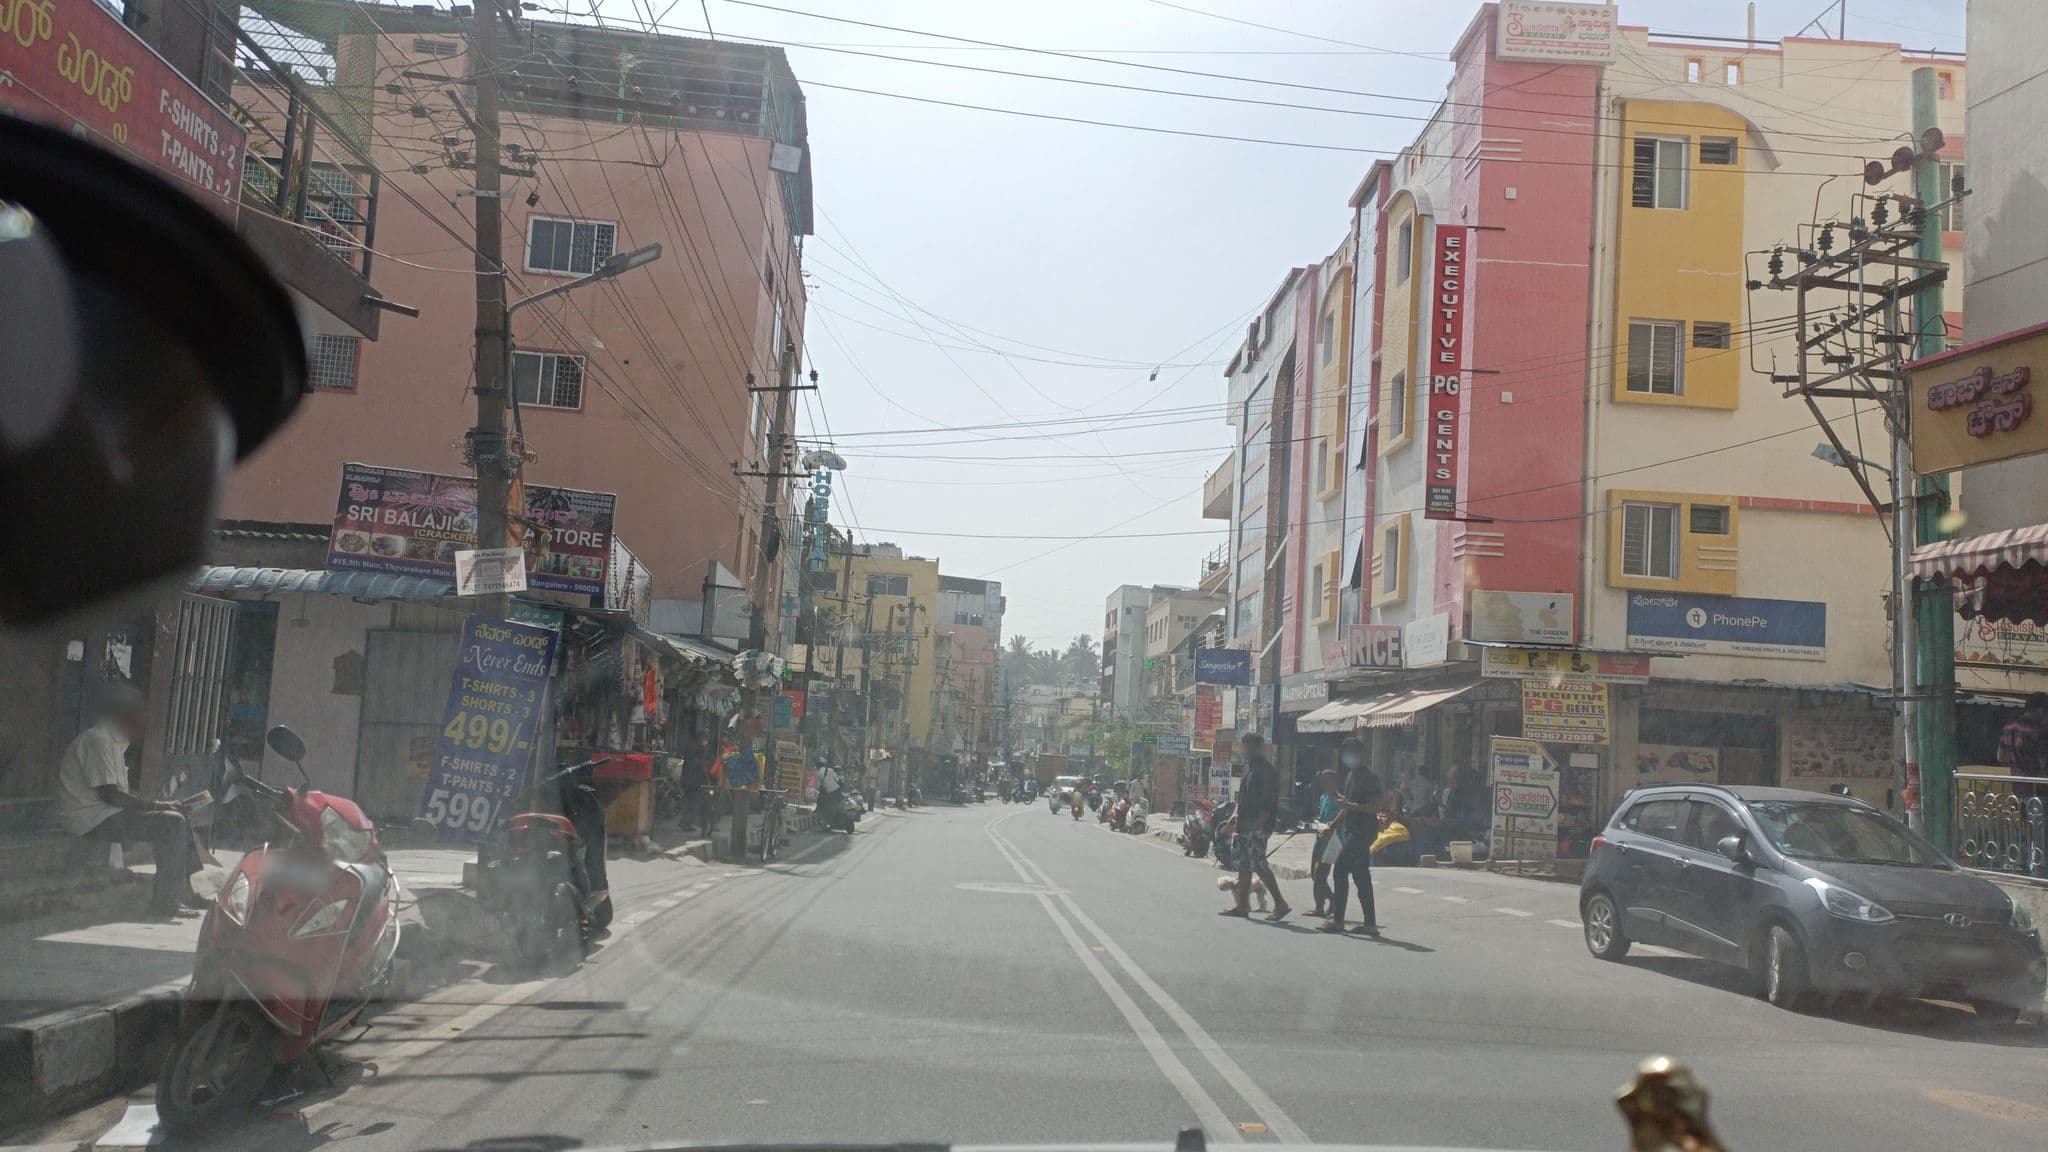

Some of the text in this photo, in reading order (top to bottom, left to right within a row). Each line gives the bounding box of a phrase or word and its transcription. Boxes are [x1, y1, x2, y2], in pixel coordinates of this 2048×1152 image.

[160, 88, 219, 155] F-SHIRTS
[227, 145, 236, 170] 2
[161, 129, 215, 189] T-PANTS
[222, 179, 231, 204] 2
[1440, 236, 1461, 363] EXECUTIVE
[1433, 375, 1459, 396] PG
[1435, 410, 1454, 480] GENTS
[347, 504, 454, 531] SRI BALAJI
[546, 527, 604, 548] STORE
[530, 578, 569, 591] Bangalore
[574, 584, 600, 593] 560029
[1713, 613, 1768, 629] PhonePe
[1351, 629, 1400, 666] RICE
[464, 645, 546, 677] Never Ends
[462, 677, 517, 698] T-SHIRTS
[528, 690, 535, 702] 3
[461, 696, 512, 715] SHORTS
[522, 707, 530, 718] 3
[1525, 700, 1563, 712] PG
[1566, 704, 1605, 713] GENTS
[441, 756, 498, 776] F-SHIRTS
[508, 769, 516, 780] 2
[442, 774, 493, 793] T-PANTS
[503, 785, 511, 797] 2
